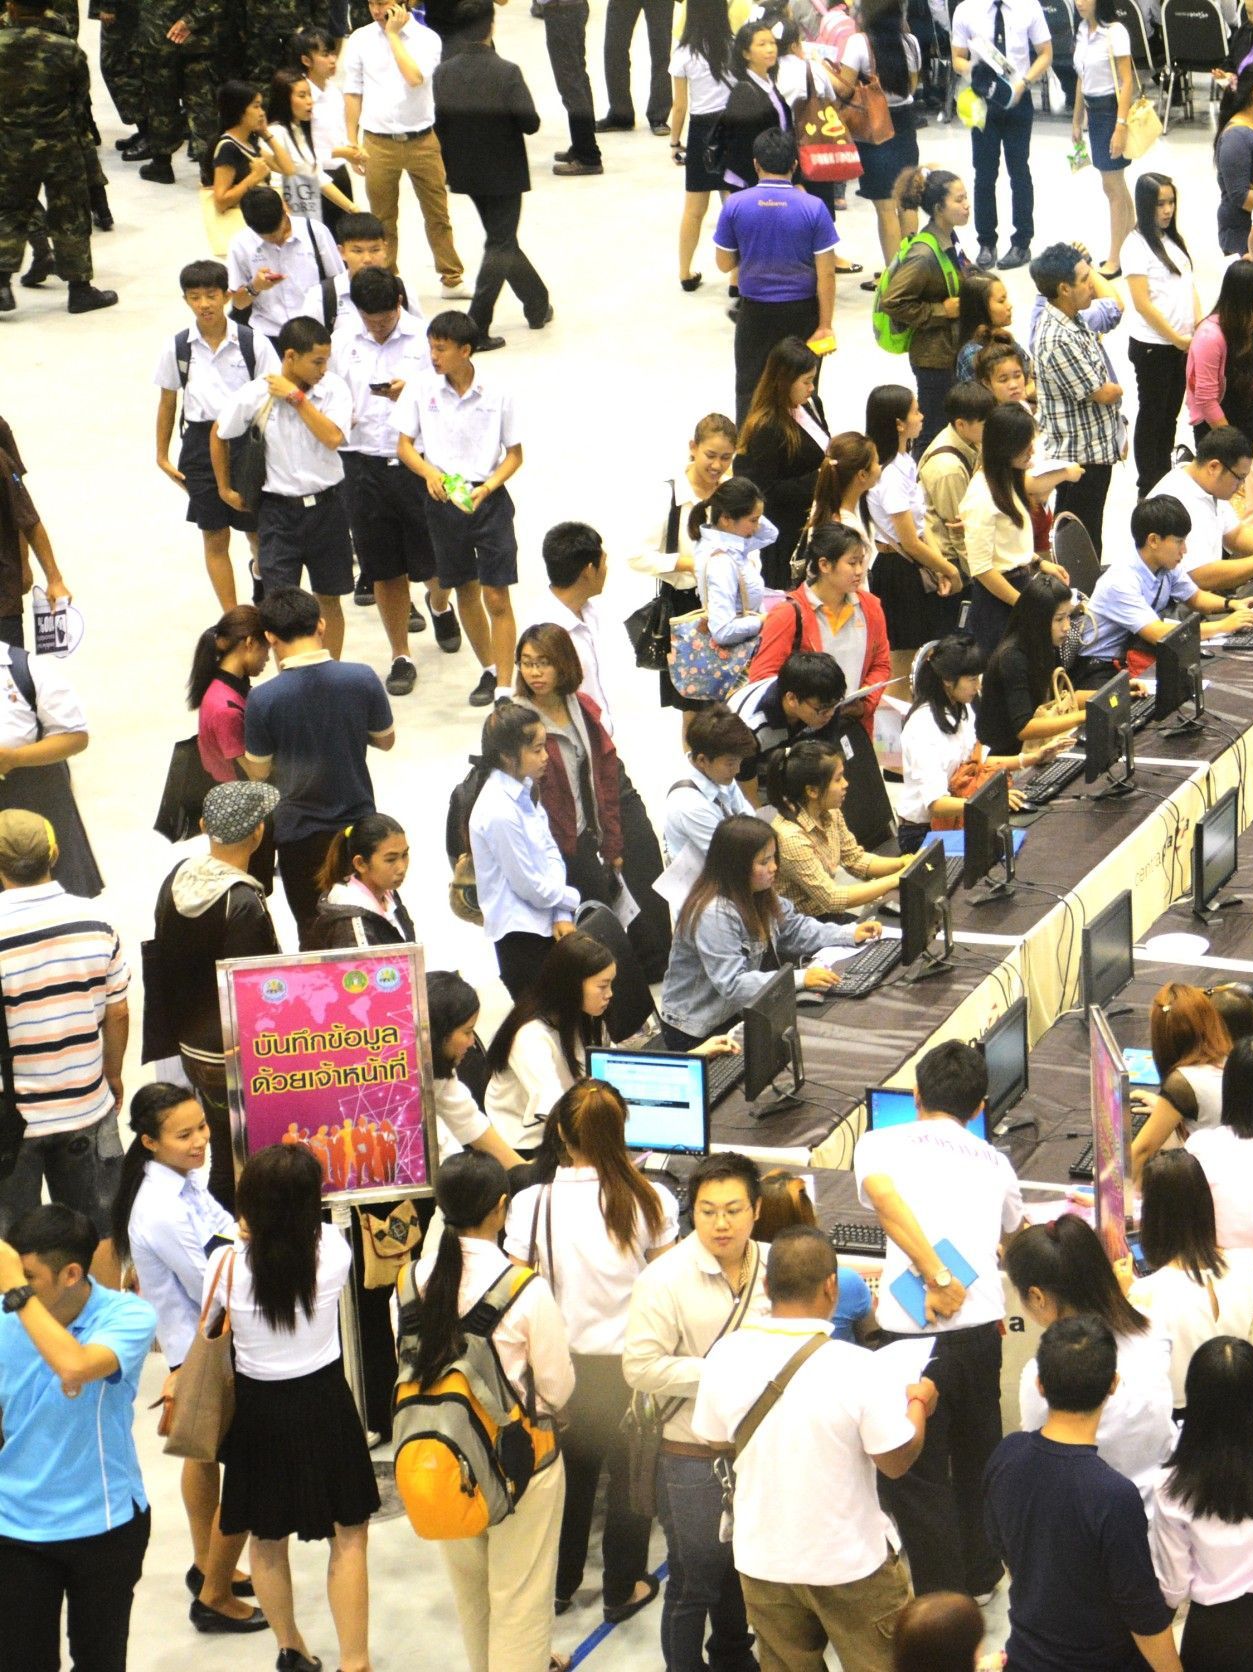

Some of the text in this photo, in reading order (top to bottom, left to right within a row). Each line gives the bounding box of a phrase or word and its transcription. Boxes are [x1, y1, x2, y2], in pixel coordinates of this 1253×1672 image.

[253, 1023, 400, 1056] บันทึกข้อมูล
[251, 1050, 408, 1094] ด้วยเจ้าหน้าที่
